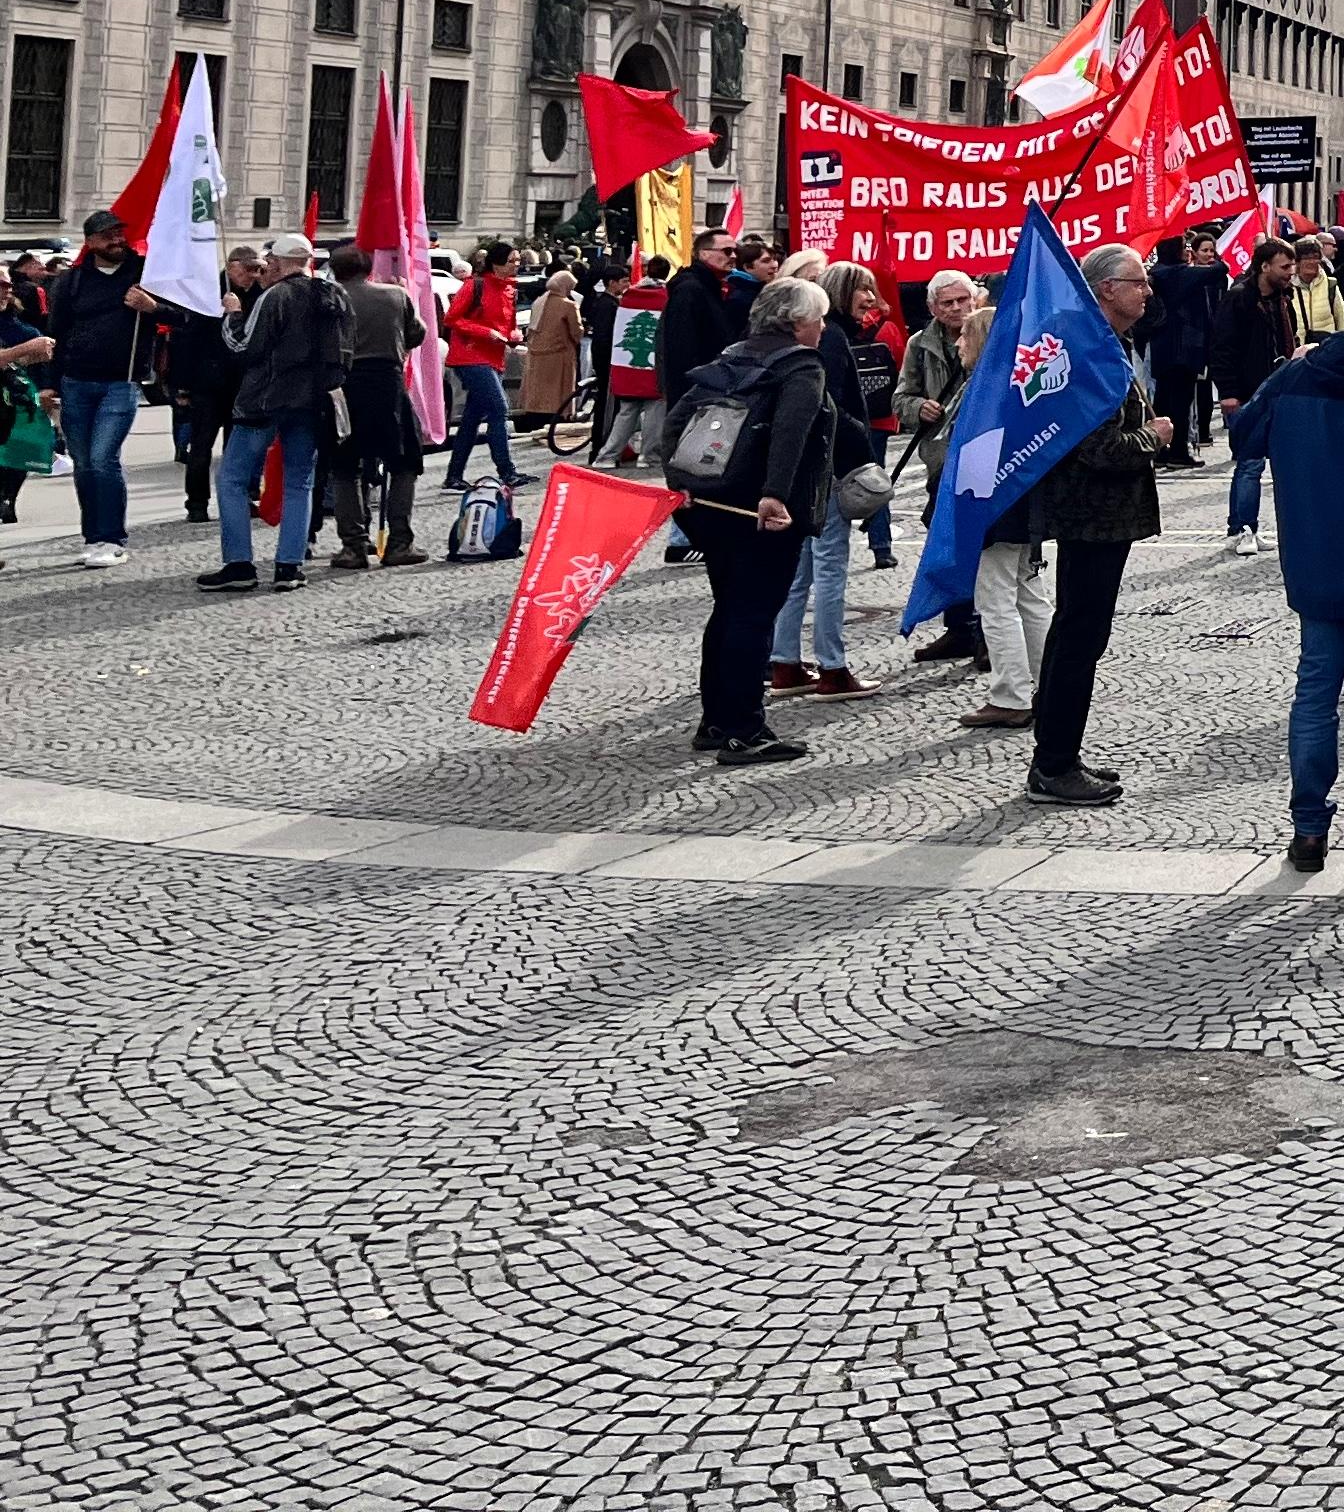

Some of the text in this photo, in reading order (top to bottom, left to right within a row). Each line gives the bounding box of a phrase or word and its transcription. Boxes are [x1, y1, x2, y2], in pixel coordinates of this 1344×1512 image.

[799, 100, 869, 139] KEIN
[1014, 129, 1063, 159] MIT
[923, 182, 1008, 209] RAUS
[1023, 174, 1083, 206] AUS
[852, 231, 933, 262] NTO
